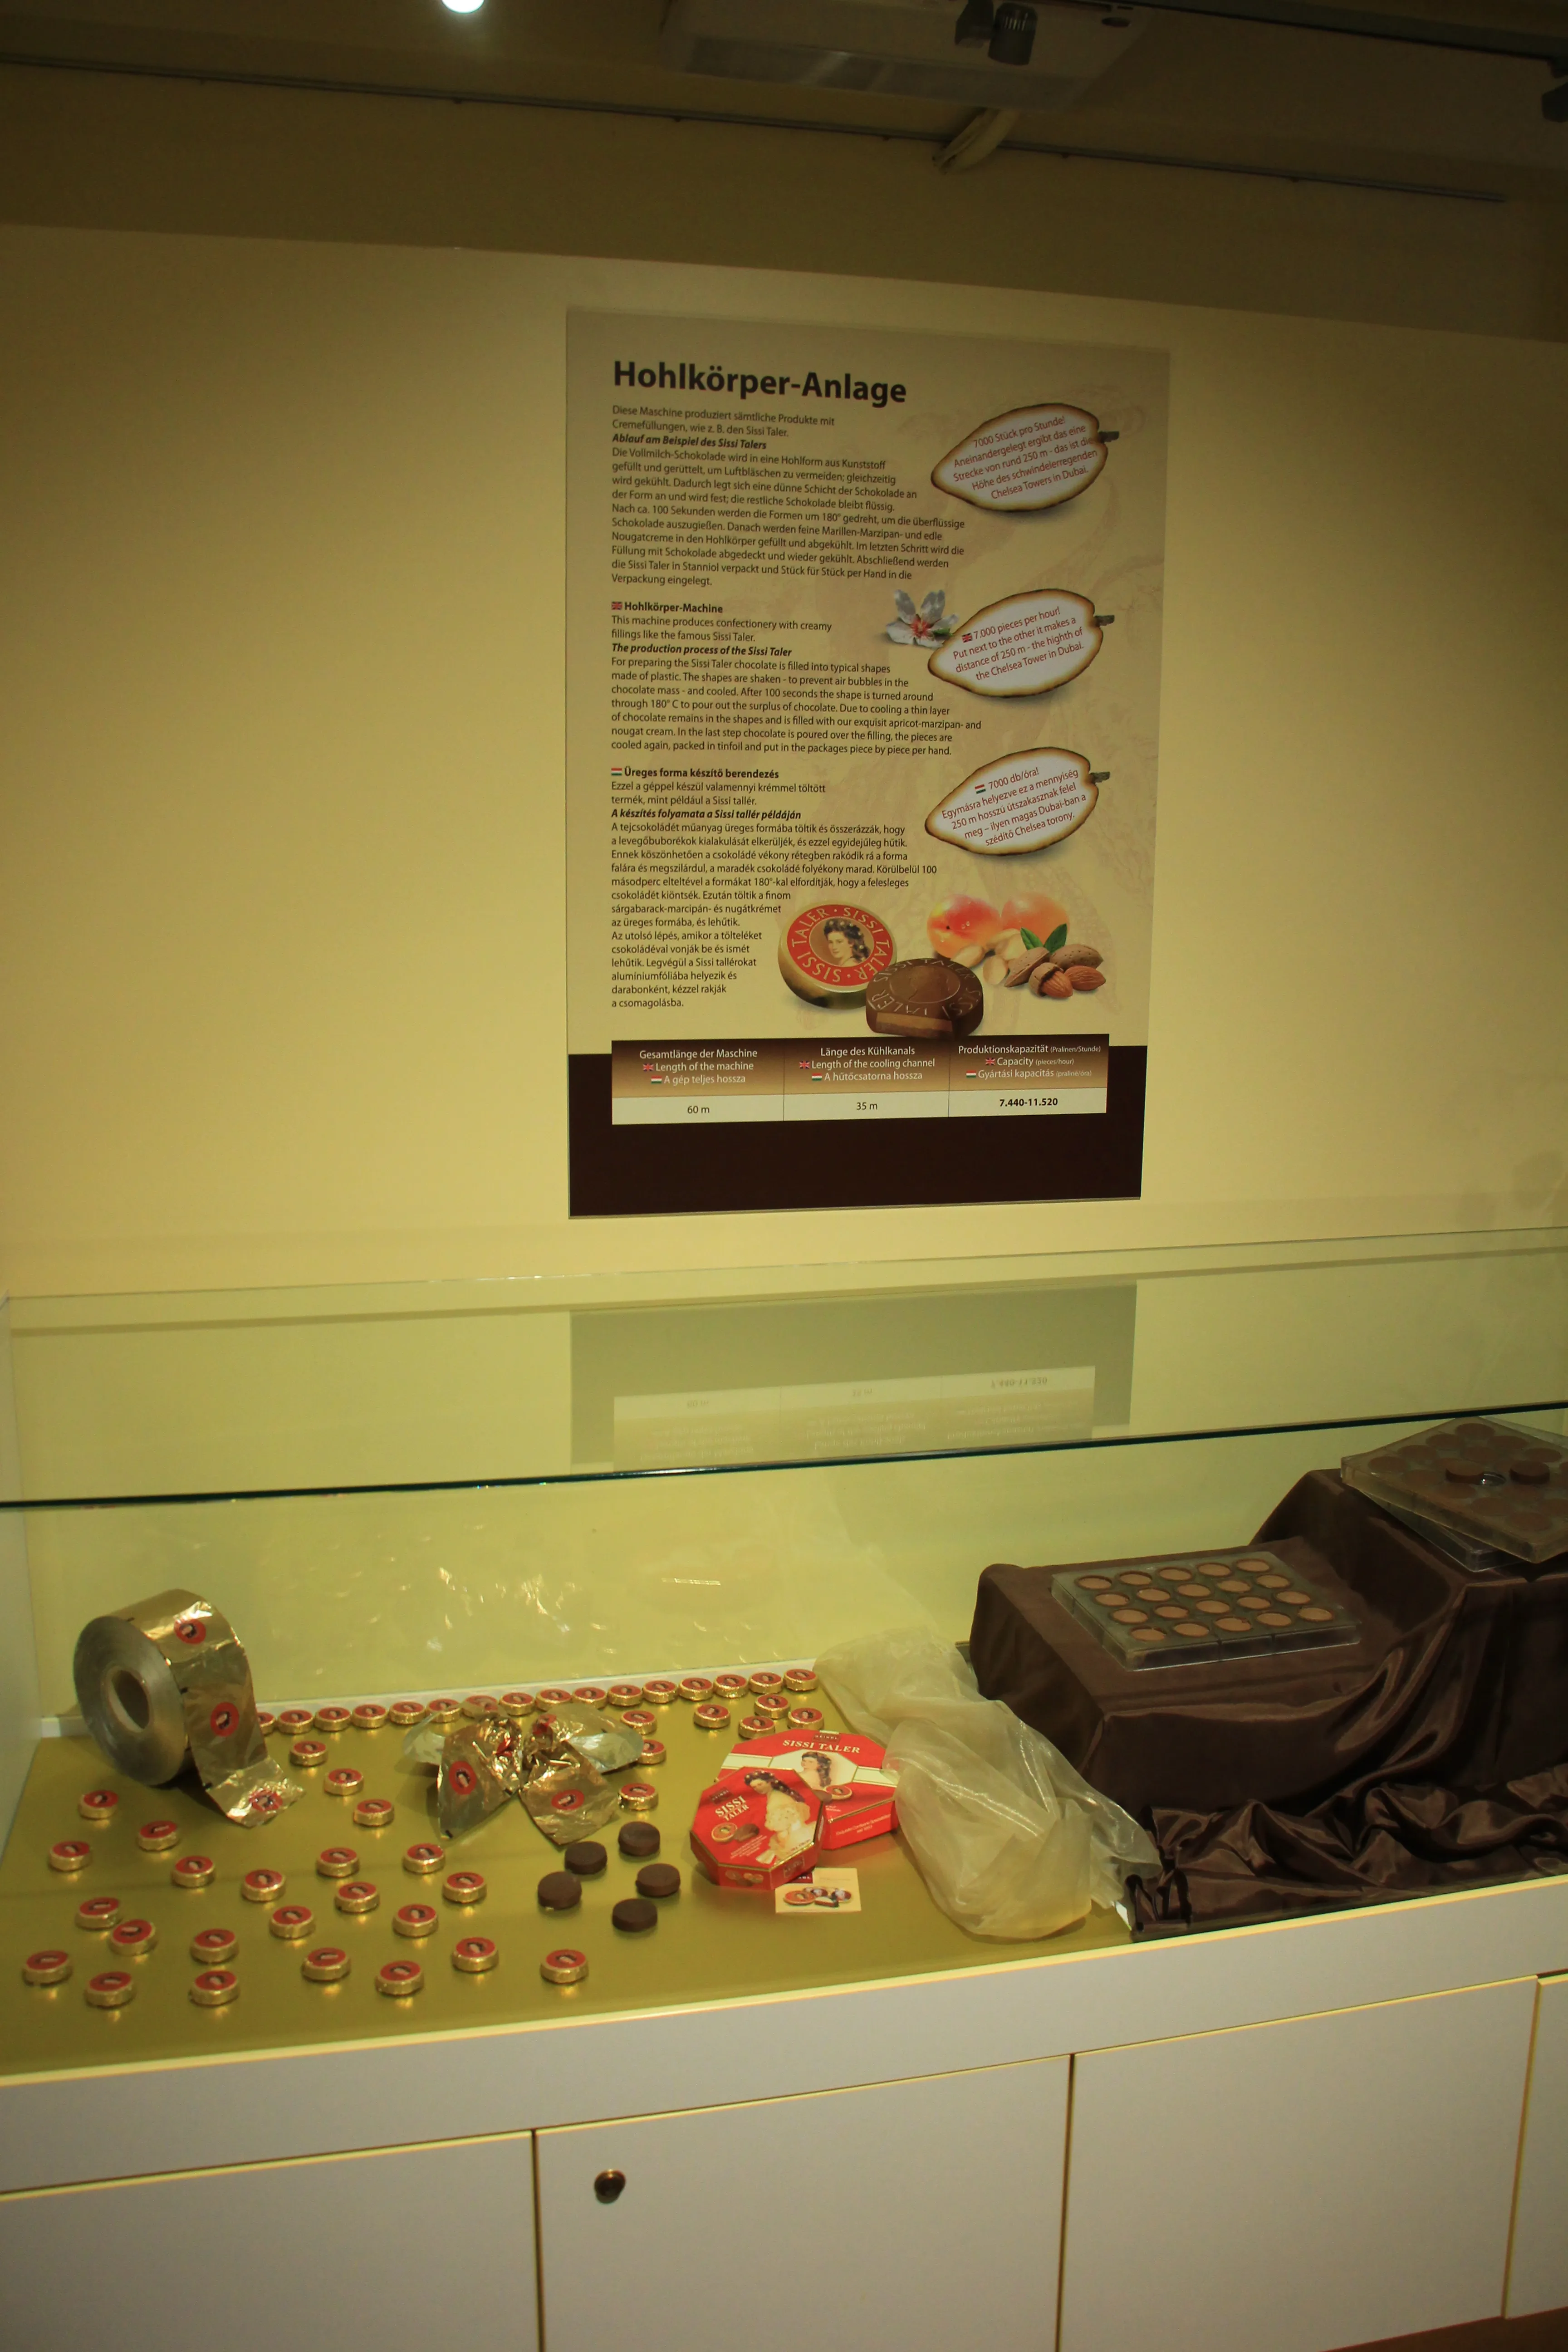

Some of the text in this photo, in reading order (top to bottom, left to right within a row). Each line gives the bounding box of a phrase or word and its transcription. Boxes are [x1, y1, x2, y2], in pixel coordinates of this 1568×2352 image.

[615, 361, 906, 408] Hohlkörper-Anlage
[612, 405, 834, 426] Diese Maschine produziert sämtliche Produkte mit
[612, 419, 687, 433] Cremefüllungen,
[690, 424, 706, 432] wie
[717, 424, 724, 433] B.
[726, 425, 744, 434] den
[746, 426, 764, 436] Sissi
[766, 426, 789, 437] Taler.
[973, 416, 1065, 448] 7000 Stück pro Stunde!
[612, 433, 645, 443] Ablauf
[663, 436, 699, 447] Beispiel
[701, 437, 716, 447] des
[718, 438, 738, 448] Sissi
[740, 439, 766, 449] Talers
[955, 426, 1086, 468] Aneinandergelegt ergibt das eine
[972, 451, 1097, 490] Höhe des schwindelerregenden
[991, 485, 1023, 499] Chelsea
[1023, 477, 1052, 490] Towers
[1062, 466, 1088, 479] Dubai.
[625, 602, 723, 613] Hohlkörper-Machine
[612, 615, 832, 632] This machine produces confectionery with creamy
[973, 606, 1060, 639] 7.000 pieces per hour!
[612, 629, 755, 642] fillings like the famous Sissi Taler.
[953, 650, 968, 660] Put
[969, 643, 987, 655] next
[998, 637, 1012, 646] the
[1014, 629, 1035, 641] other
[1044, 619, 1070, 632] makes
[612, 643, 792, 657] The production process of the Sissi Taler
[976, 671, 990, 680] the
[991, 662, 1022, 676] Chelsea
[1022, 654, 1047, 666] Tower
[1058, 643, 1083, 655] Dubai.
[624, 766, 779, 779] Üreges forma készítő berendezés
[988, 767, 1039, 789] 7000 db/óra!
[942, 801, 981, 819] Egymásra
[982, 789, 1017, 806] helyezve
[1019, 786, 1028, 794] ez
[1035, 769, 1078, 789] mennyiség
[951, 818, 967, 829] 250
[977, 805, 1005, 821] hosszú
[1007, 788, 1058, 811] útszakasznak
[1059, 782, 1076, 794] felel
[611, 809, 617, 817] A
[620, 808, 656, 818] készítés
[658, 809, 705, 820] folyamata
[715, 809, 735, 818] Sissi
[736, 810, 760, 818] tallér
[761, 810, 801, 821] példáján
[985, 812, 1074, 846] szédítő Chelsea torony.
[792, 907, 841, 982] SISSI TALER
[843, 907, 890, 980] SISSI TALER
[612, 984, 726, 995] darabonként, kézzel rakják
[619, 998, 683, 1009] csomagolásba.
[639, 1049, 757, 1060] Gesamtlänge der Maschine
[821, 1046, 915, 1058] Länge des Kühlkanals
[959, 1044, 1049, 1055] Produktionskapazität
[656, 1061, 754, 1073] Length of the machine
[812, 1058, 935, 1071] Length of the cooling channel
[997, 1057, 1034, 1067] Capacity
[664, 1074, 745, 1086] A gép teljes hossza
[824, 1071, 922, 1081] A hűtőcsatorna hossza
[978, 1069, 1012, 1080] Gyártási
[1015, 1068, 1054, 1079] kapacitás
[687, 1106, 698, 1114] 60
[857, 1102, 867, 1110] 35
[1000, 1098, 1058, 1107] 7.440-11.520
[783, 1740, 861, 1754] SISSI TALER
[715, 1795, 746, 1817] SISSI
[723, 1804, 750, 1821] TALER
